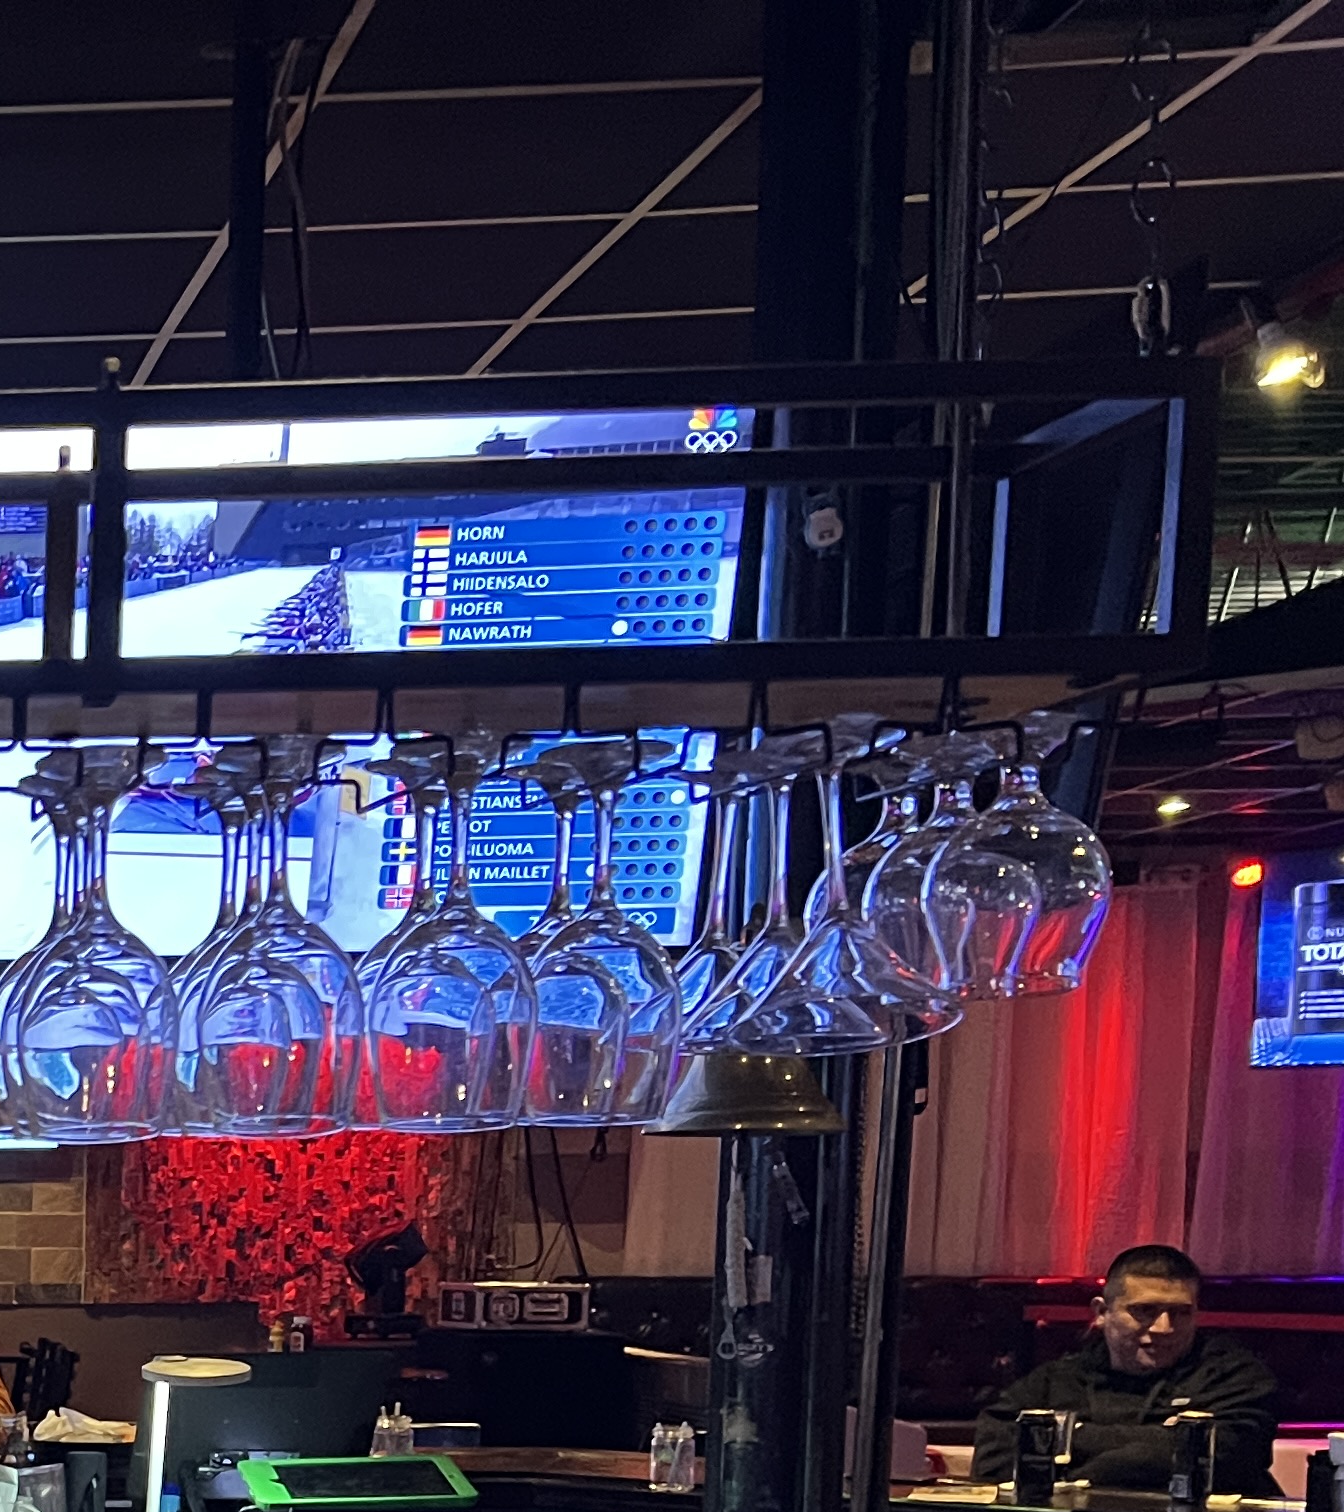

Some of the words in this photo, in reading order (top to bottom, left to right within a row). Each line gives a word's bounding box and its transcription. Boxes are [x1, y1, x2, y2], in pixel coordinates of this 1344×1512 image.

[456, 526, 506, 542] HORN
[455, 550, 528, 567] HARJULA
[452, 574, 550, 591] HIIDENSALO
[451, 601, 504, 616] HOFER
[448, 625, 532, 641] NAWRATH
[484, 865, 550, 880] MAILLET
